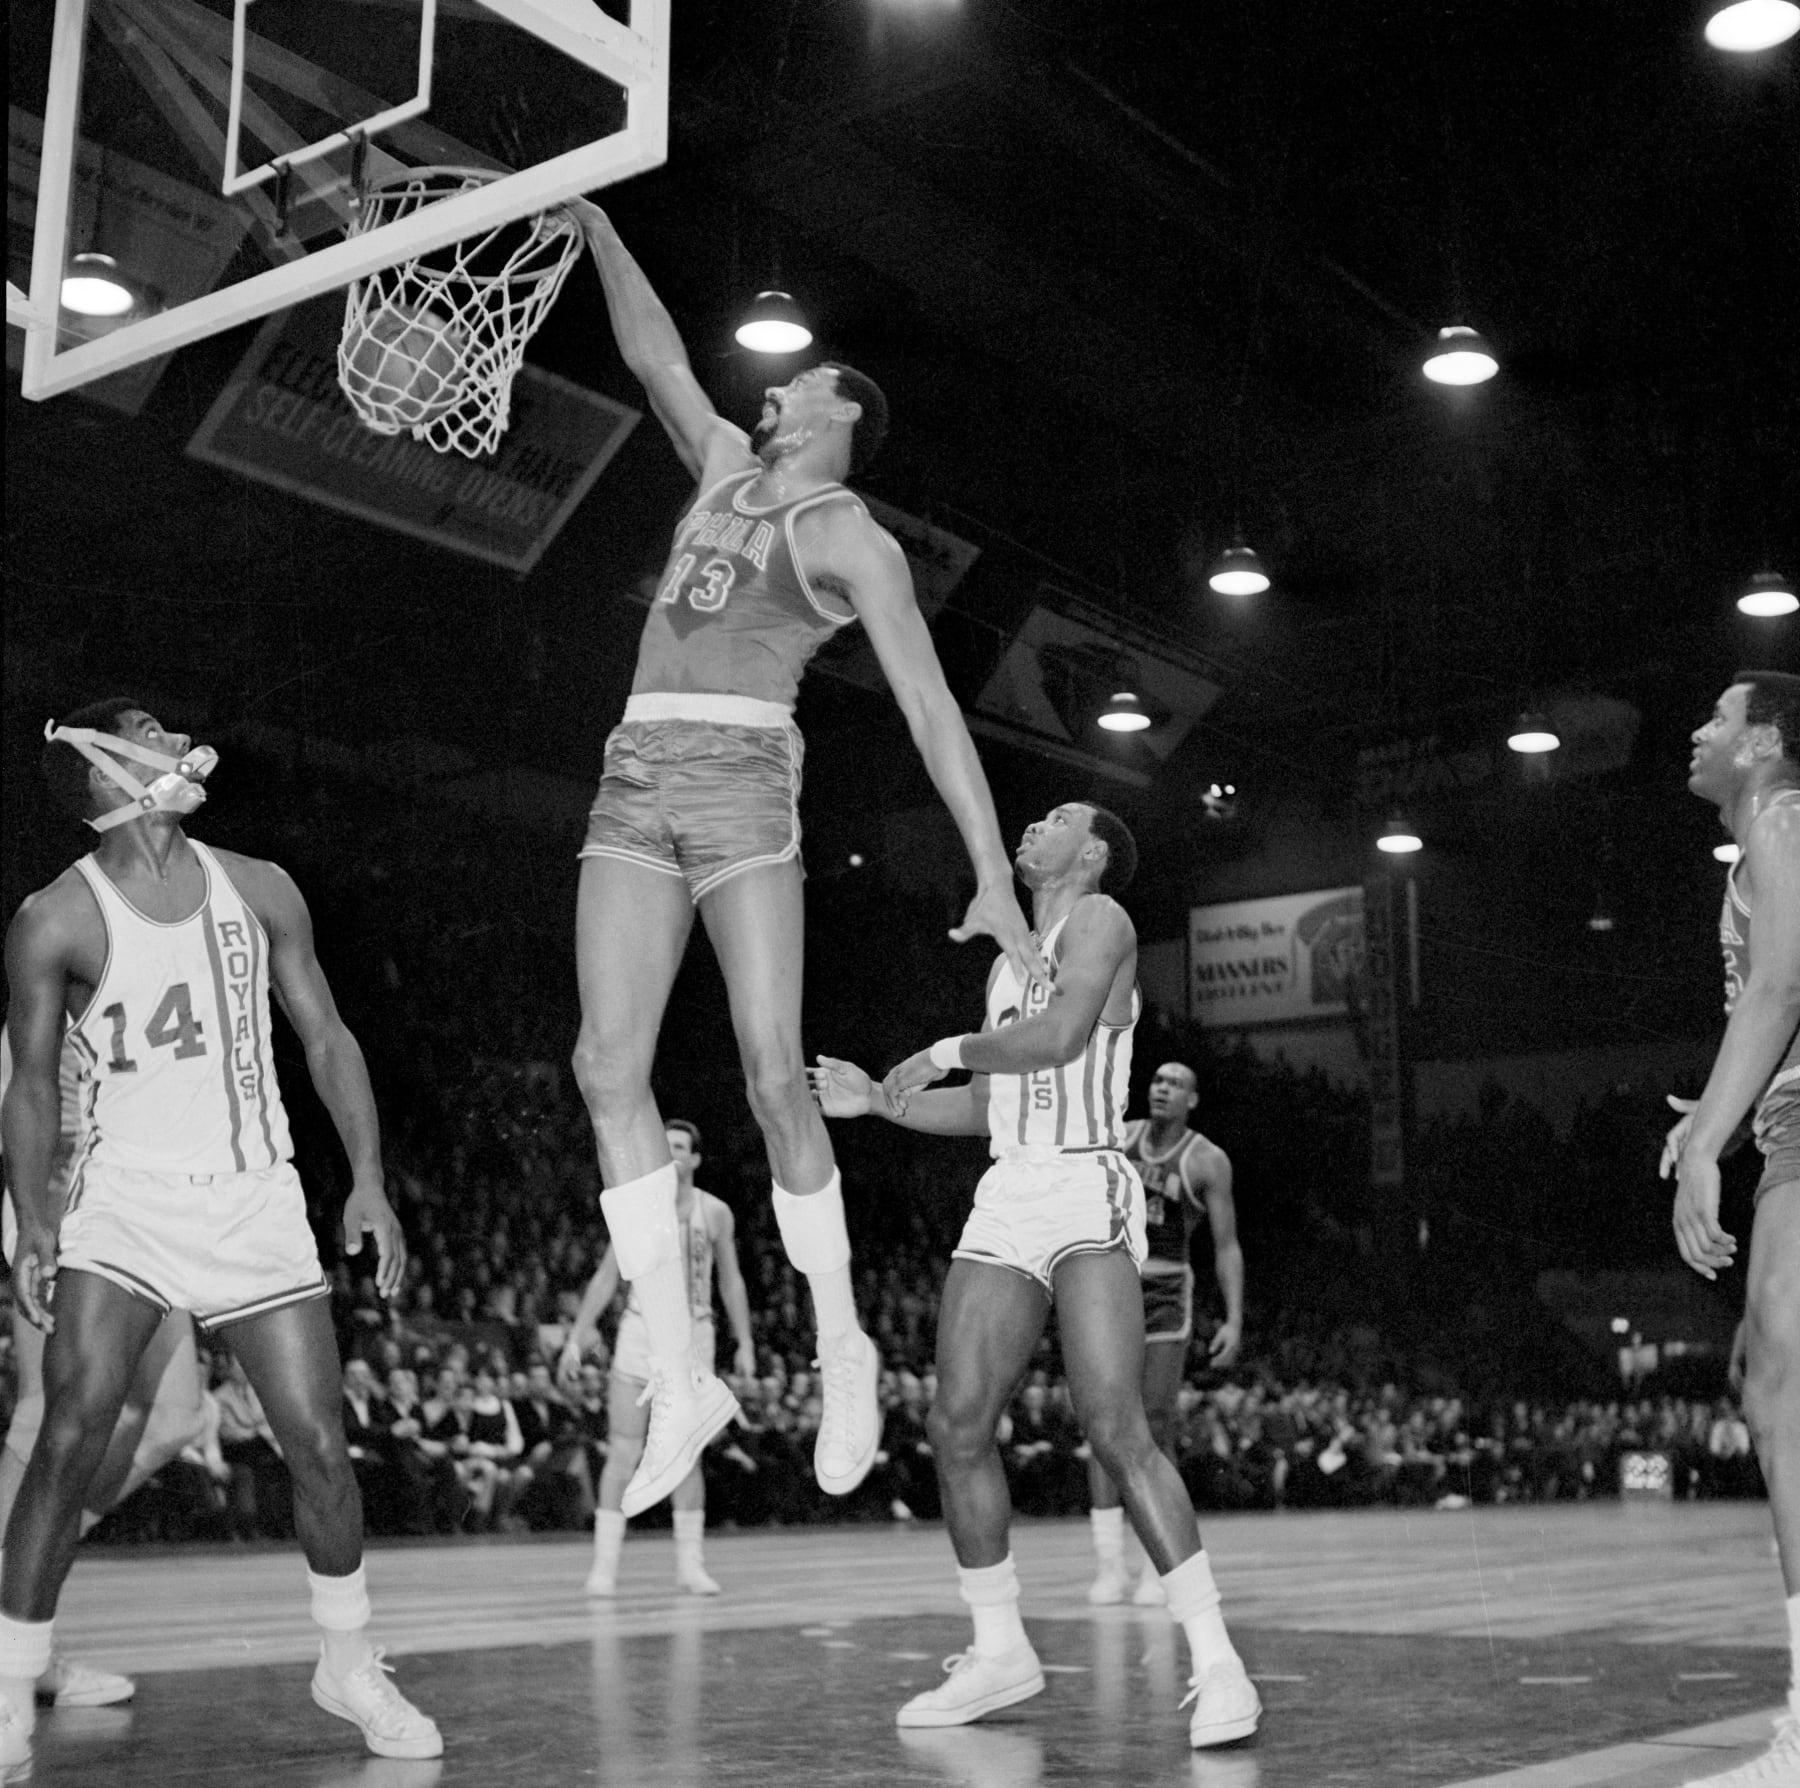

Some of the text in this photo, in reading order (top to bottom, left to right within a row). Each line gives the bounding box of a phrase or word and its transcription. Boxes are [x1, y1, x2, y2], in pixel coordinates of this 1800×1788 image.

[675, 511, 774, 572] PHILA
[659, 555, 736, 611] 13
[103, 982, 207, 1073] 14
[218, 921, 257, 1100] ROYALS
